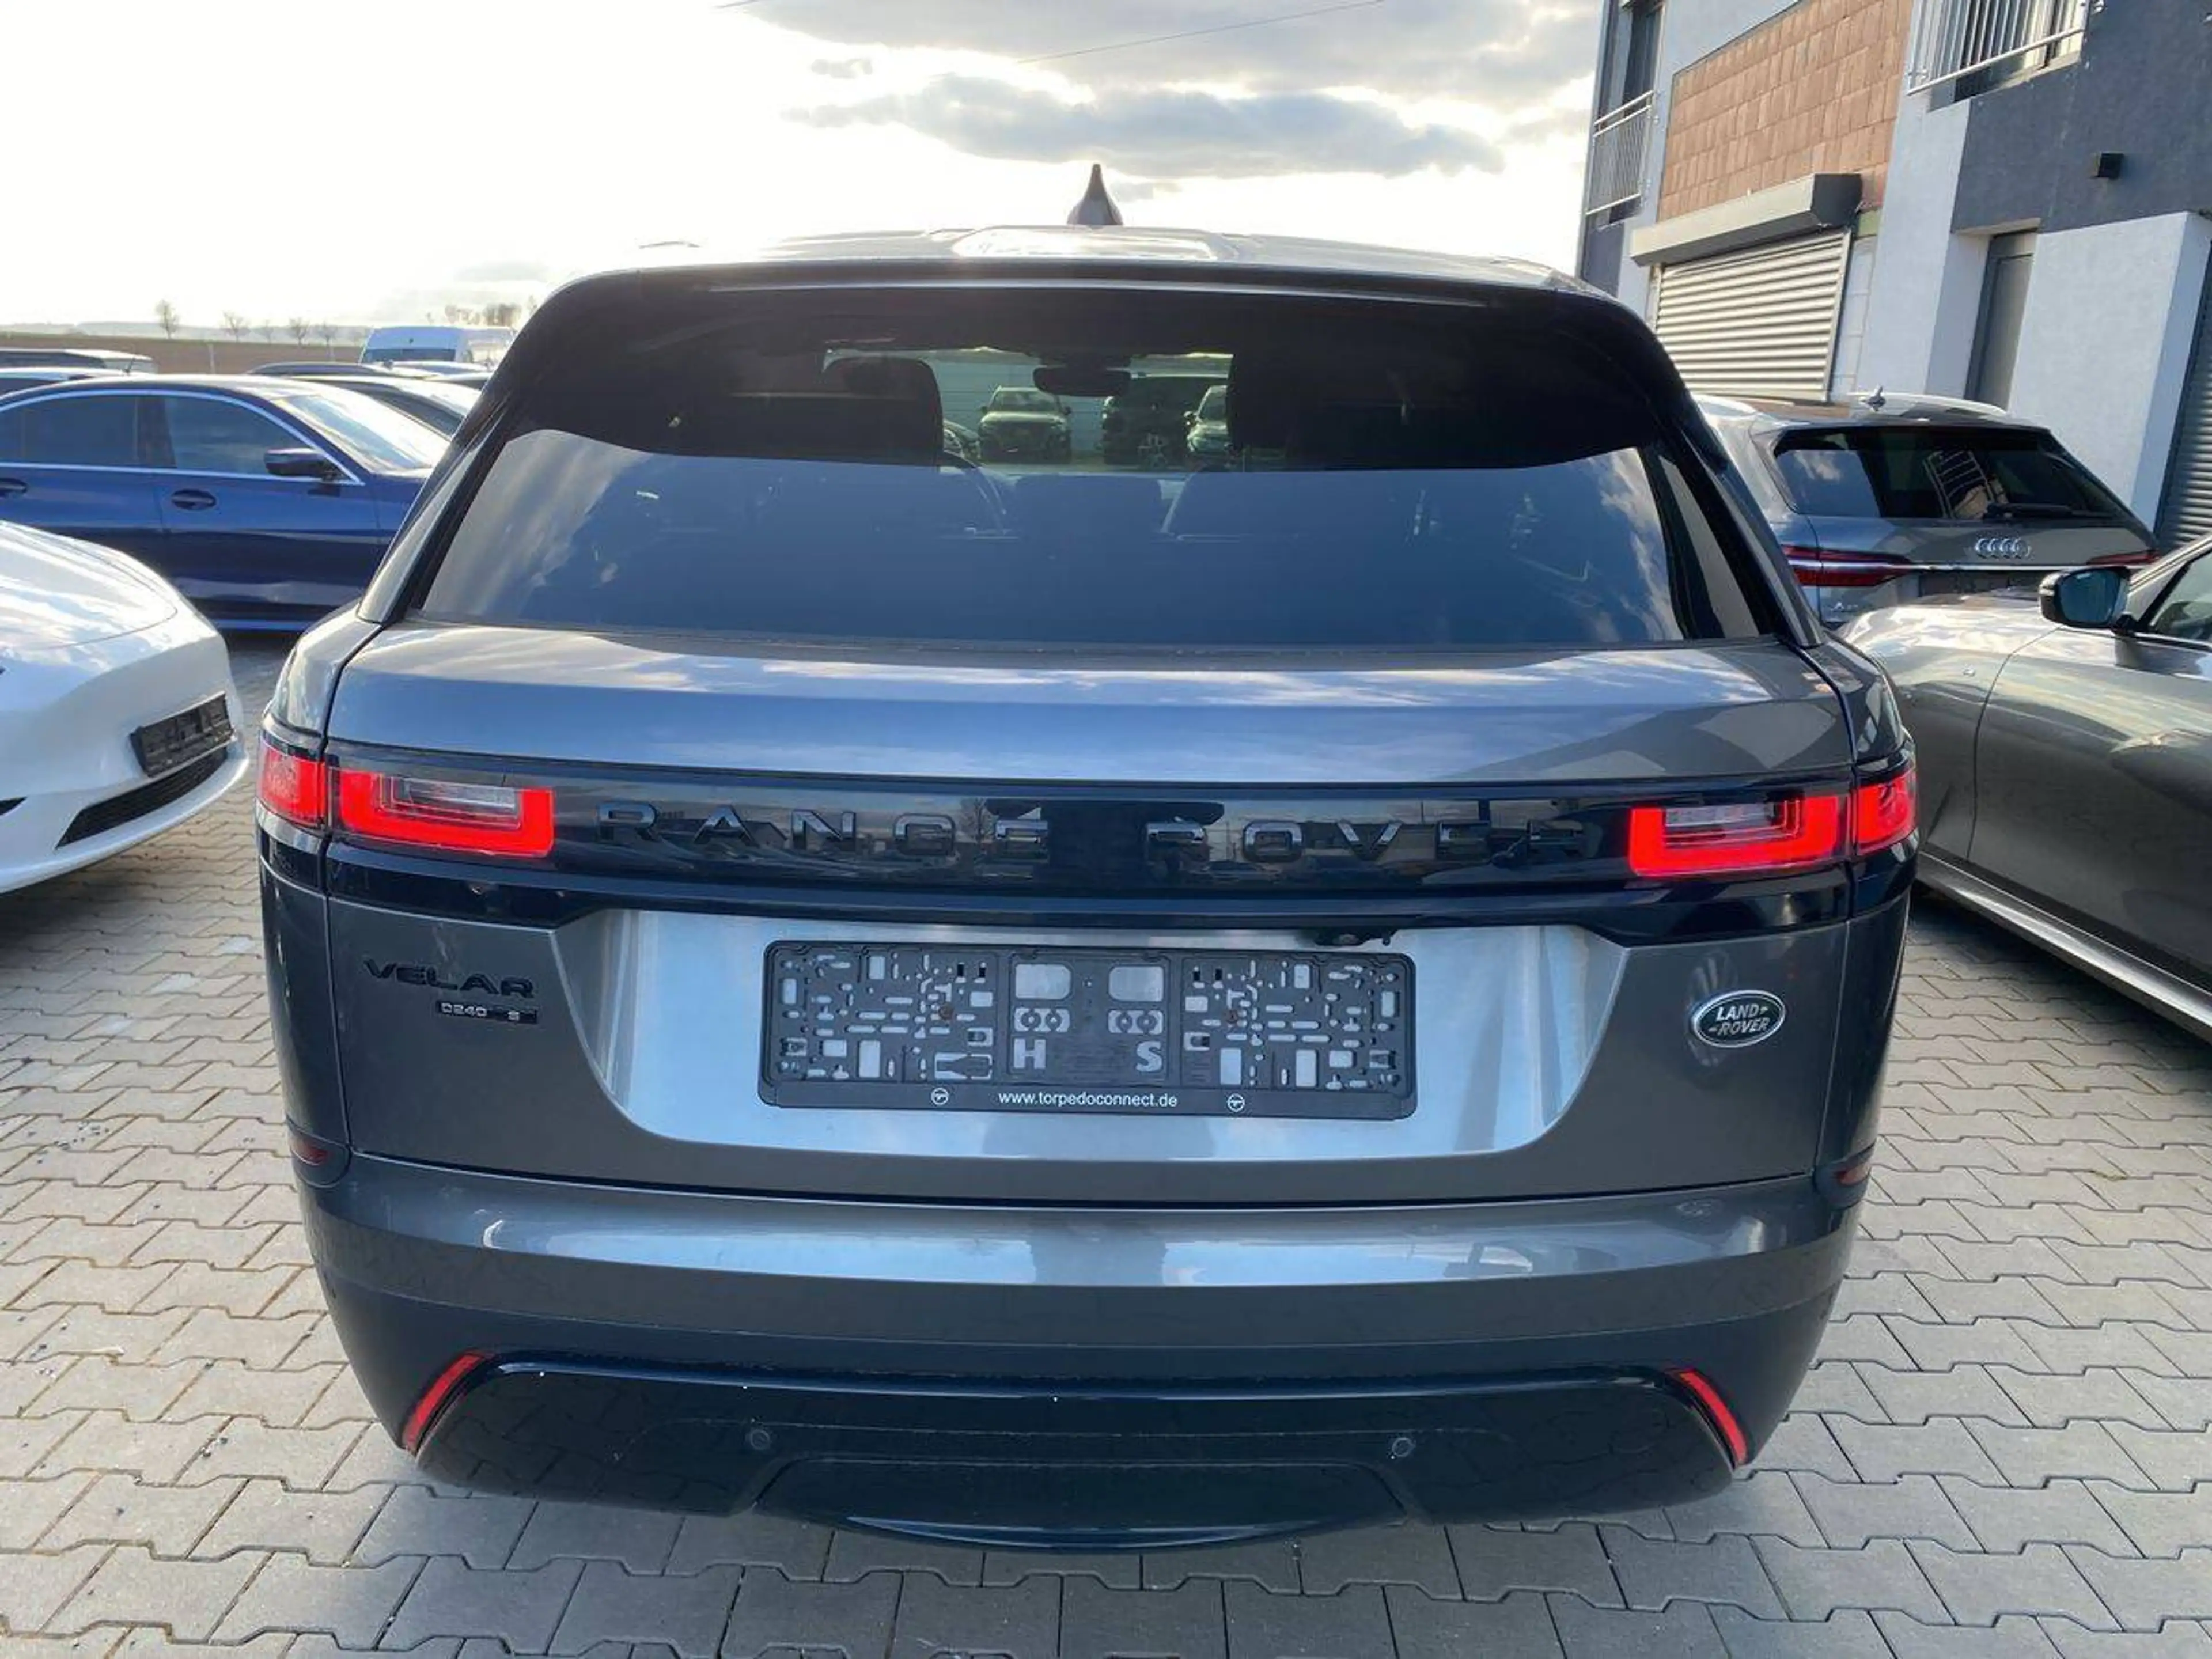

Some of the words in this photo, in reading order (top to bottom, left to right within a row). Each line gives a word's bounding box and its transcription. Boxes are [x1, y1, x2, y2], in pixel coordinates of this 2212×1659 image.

[597, 800, 1048, 864] RANGE
[363, 958, 535, 998] VELAR
[1715, 1003, 1759, 1021] LAND
[1718, 1017, 1770, 1036] ROVER
[998, 1092, 1178, 1107] www.torpedoconnect.de
